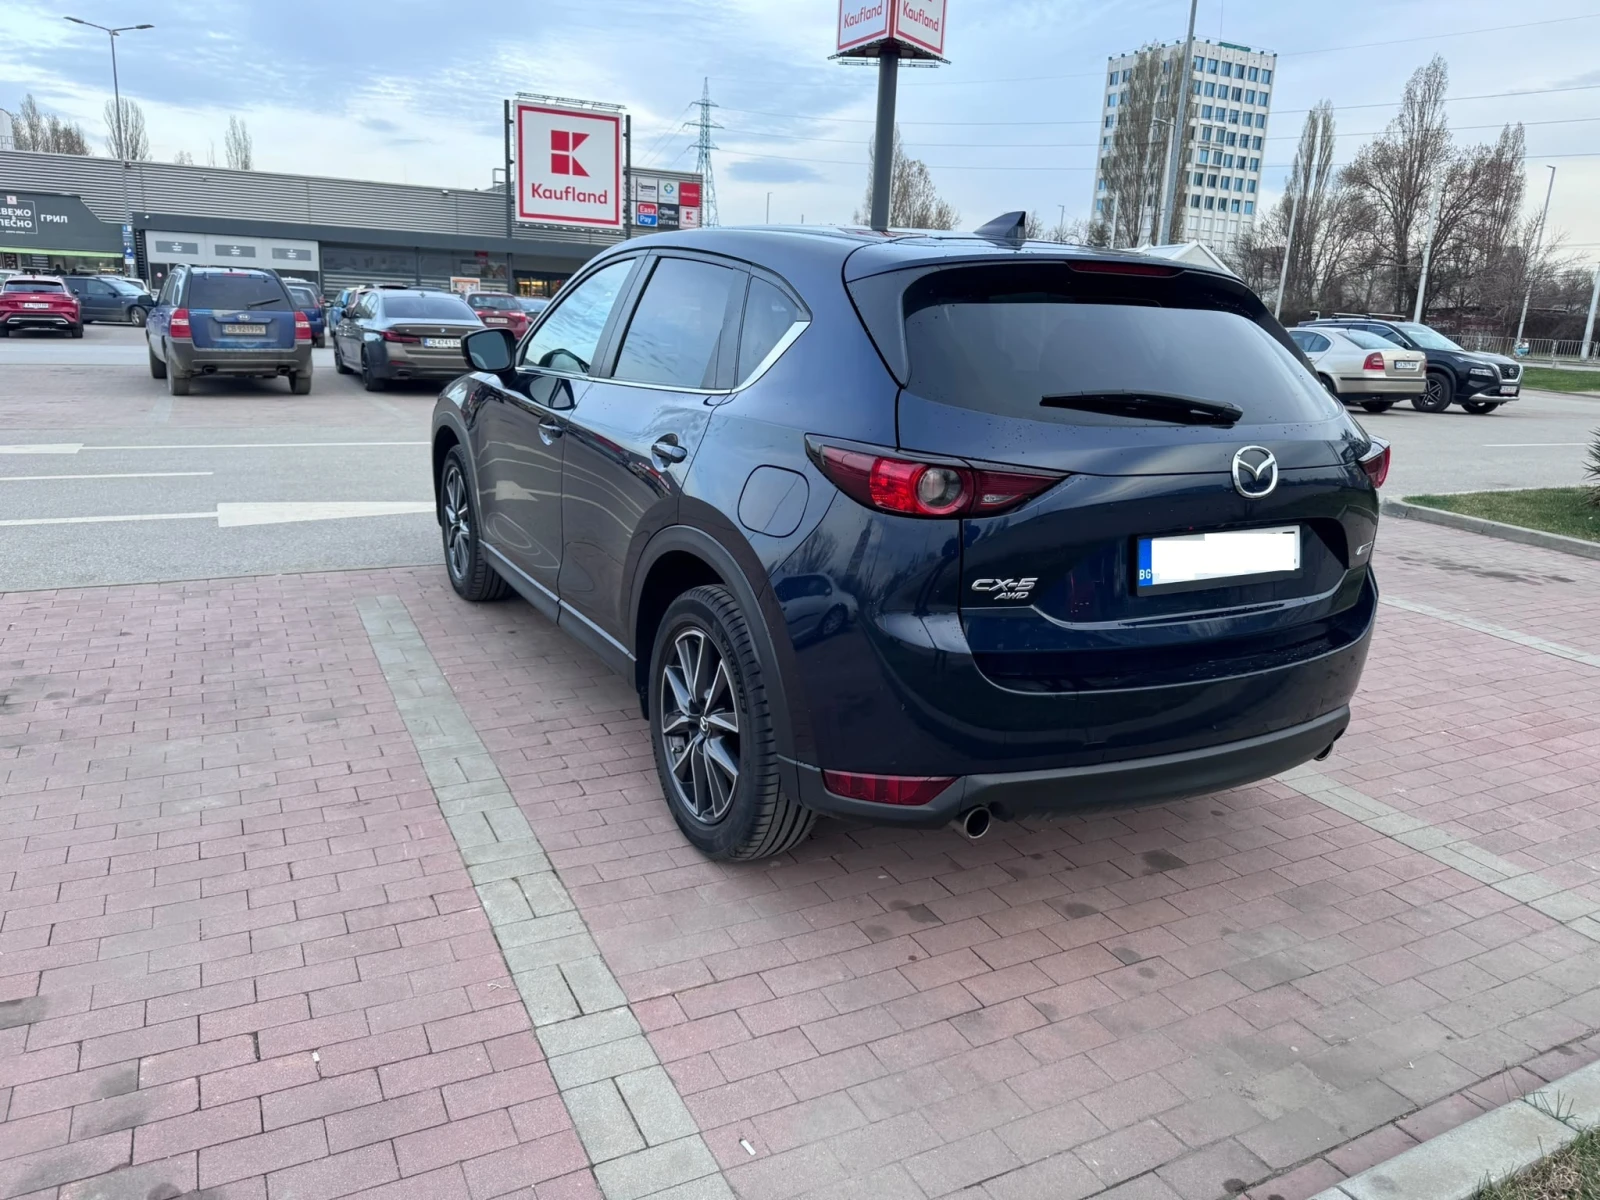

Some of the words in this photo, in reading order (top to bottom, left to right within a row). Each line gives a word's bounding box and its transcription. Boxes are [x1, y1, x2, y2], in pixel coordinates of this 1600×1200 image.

[844, 1, 882, 28] Kaufland
[903, 1, 940, 32] Kaufland
[531, 182, 608, 205] Kaufland
[0, 207, 31, 217] ВЕЖО
[639, 205, 656, 214] Easy
[40, 213, 68, 223] ГРИЛ
[640, 214, 652, 224] Pay
[1139, 568, 1152, 580] BG
[971, 577, 1038, 592] CX-5
[994, 591, 1029, 600] AWD
